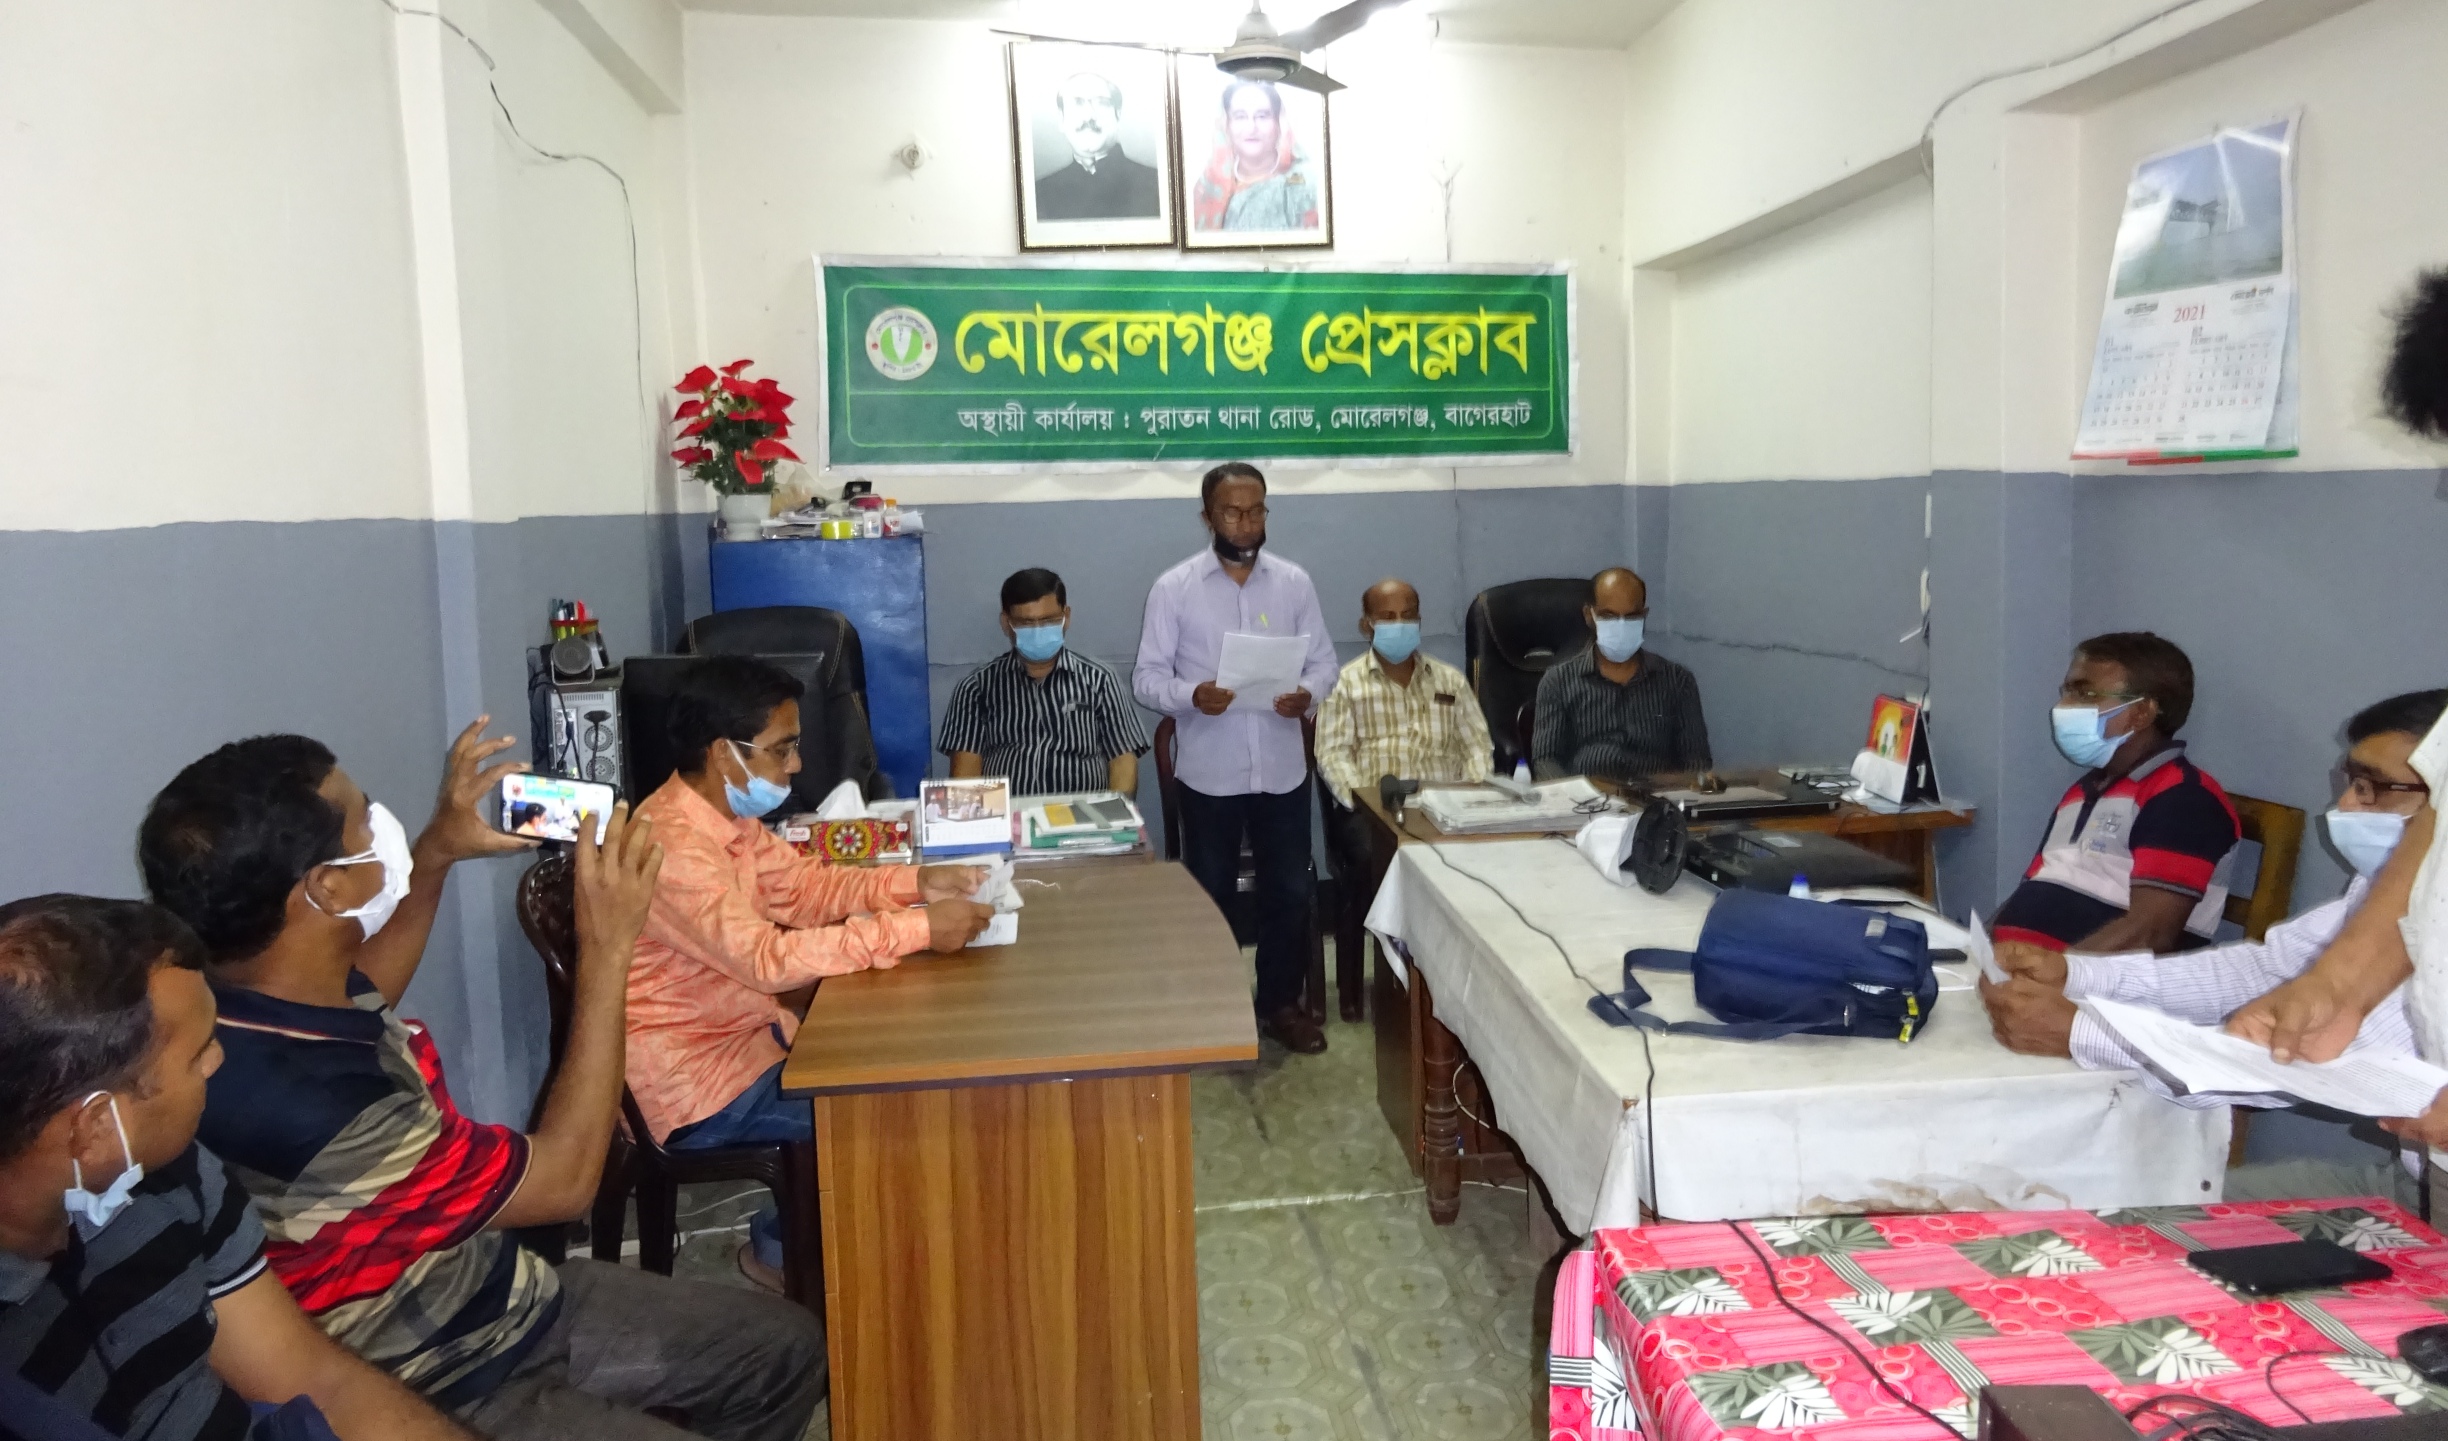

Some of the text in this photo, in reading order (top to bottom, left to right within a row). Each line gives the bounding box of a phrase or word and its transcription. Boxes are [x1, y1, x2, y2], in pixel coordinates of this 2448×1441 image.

[2173, 305, 2206, 323] 2021
[955, 301, 1538, 380] মোরেলগঞ্জ প্রেসক্লাব
[957, 400, 1026, 437] অস্থায়ী
[1033, 402, 1115, 431] কার্যালয়
[1140, 405, 1211, 436] পুরাতন
[1218, 405, 1261, 430] থানা
[1269, 404, 1321, 434] রোড,
[1331, 403, 1436, 432] মোরেলগঞ্জ,
[1443, 399, 1532, 428] বাগেরহাট
